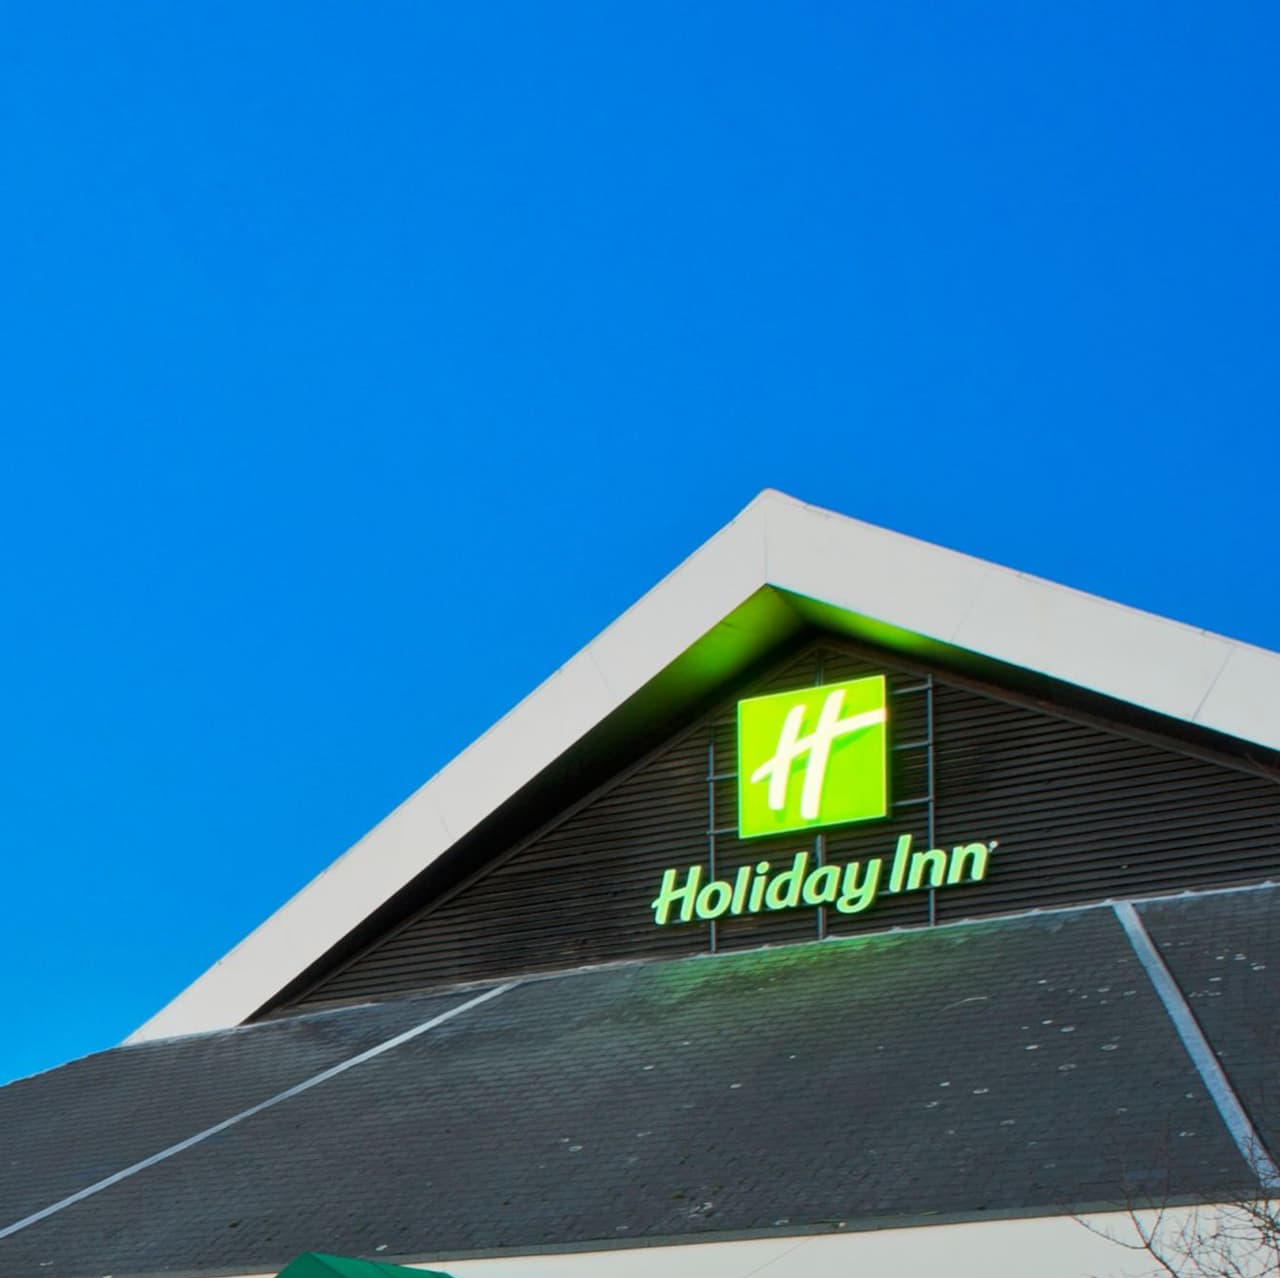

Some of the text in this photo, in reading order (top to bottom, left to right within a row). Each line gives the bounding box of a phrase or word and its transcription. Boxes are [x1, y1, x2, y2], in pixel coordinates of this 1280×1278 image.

[750, 688, 887, 820] H
[651, 833, 990, 925] Holiday Inn
